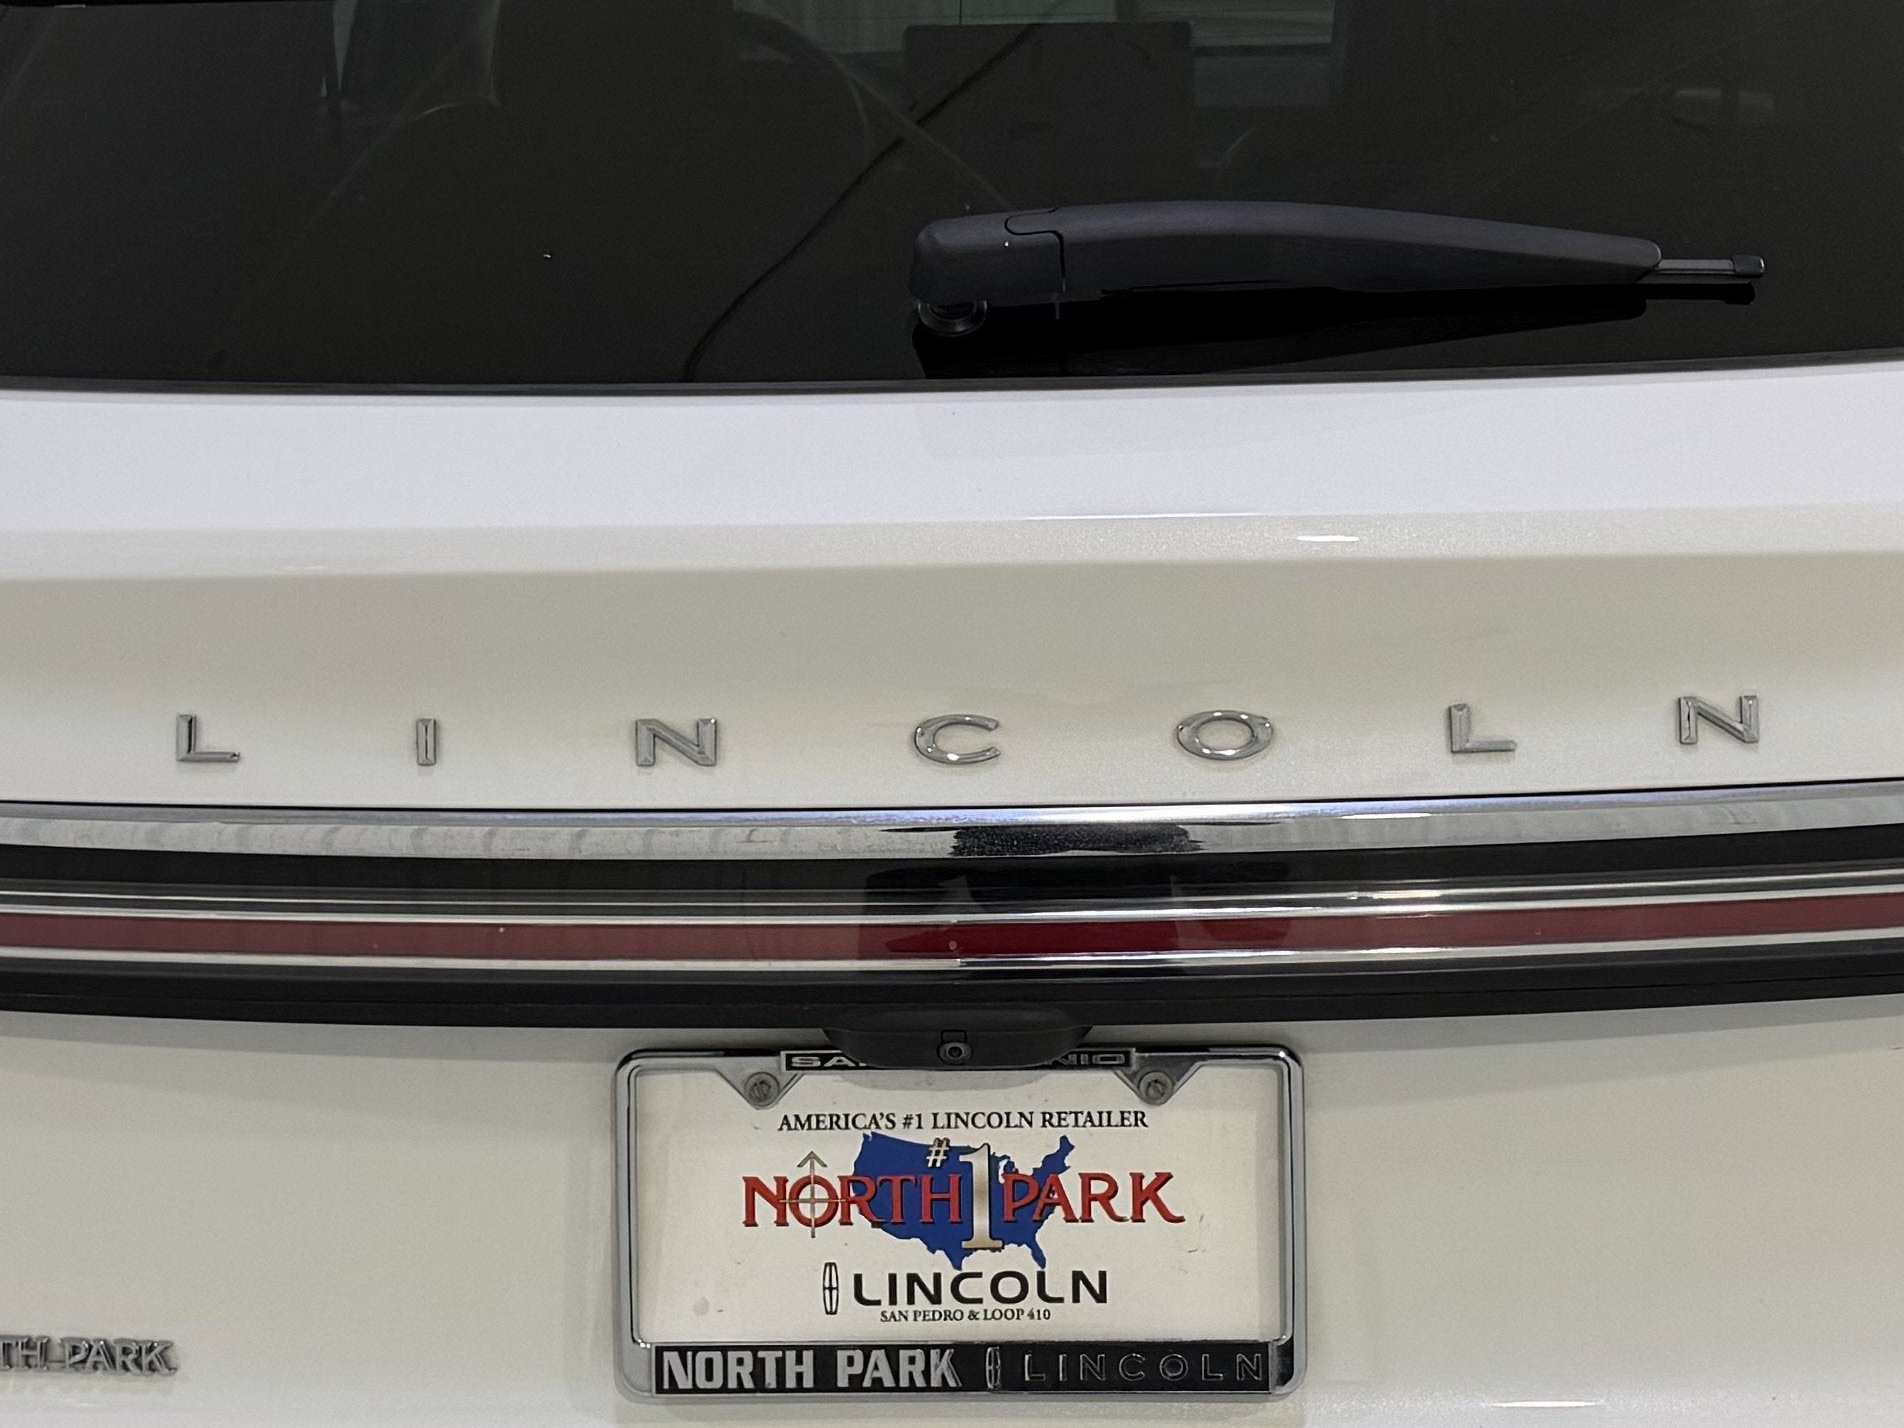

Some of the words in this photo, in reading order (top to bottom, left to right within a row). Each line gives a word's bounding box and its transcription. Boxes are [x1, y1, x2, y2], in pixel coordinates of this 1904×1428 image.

[176, 695, 1759, 769] LINCOLN
[791, 1056, 866, 1067] SA
[778, 1113, 896, 1131] AMERICA'S
[902, 1113, 924, 1129] #1
[931, 1111, 1035, 1130] LINCOLN
[1040, 1110, 1149, 1128] RETAILER
[742, 1174, 962, 1228] NORTH
[1001, 1171, 1186, 1225] PARK
[853, 1270, 1107, 1306] LINCOLN
[880, 1310, 909, 1323] SAN
[912, 1309, 964, 1322] PEDRO
[967, 1310, 980, 1321] &
[983, 1308, 1024, 1321] LOOP
[1026, 1308, 1051, 1321] 410
[59, 1337, 178, 1376] PARK
[662, 1350, 814, 1389] NORTH
[835, 1349, 962, 1388] PARK
[1025, 1352, 1265, 1383] LINCOLN
